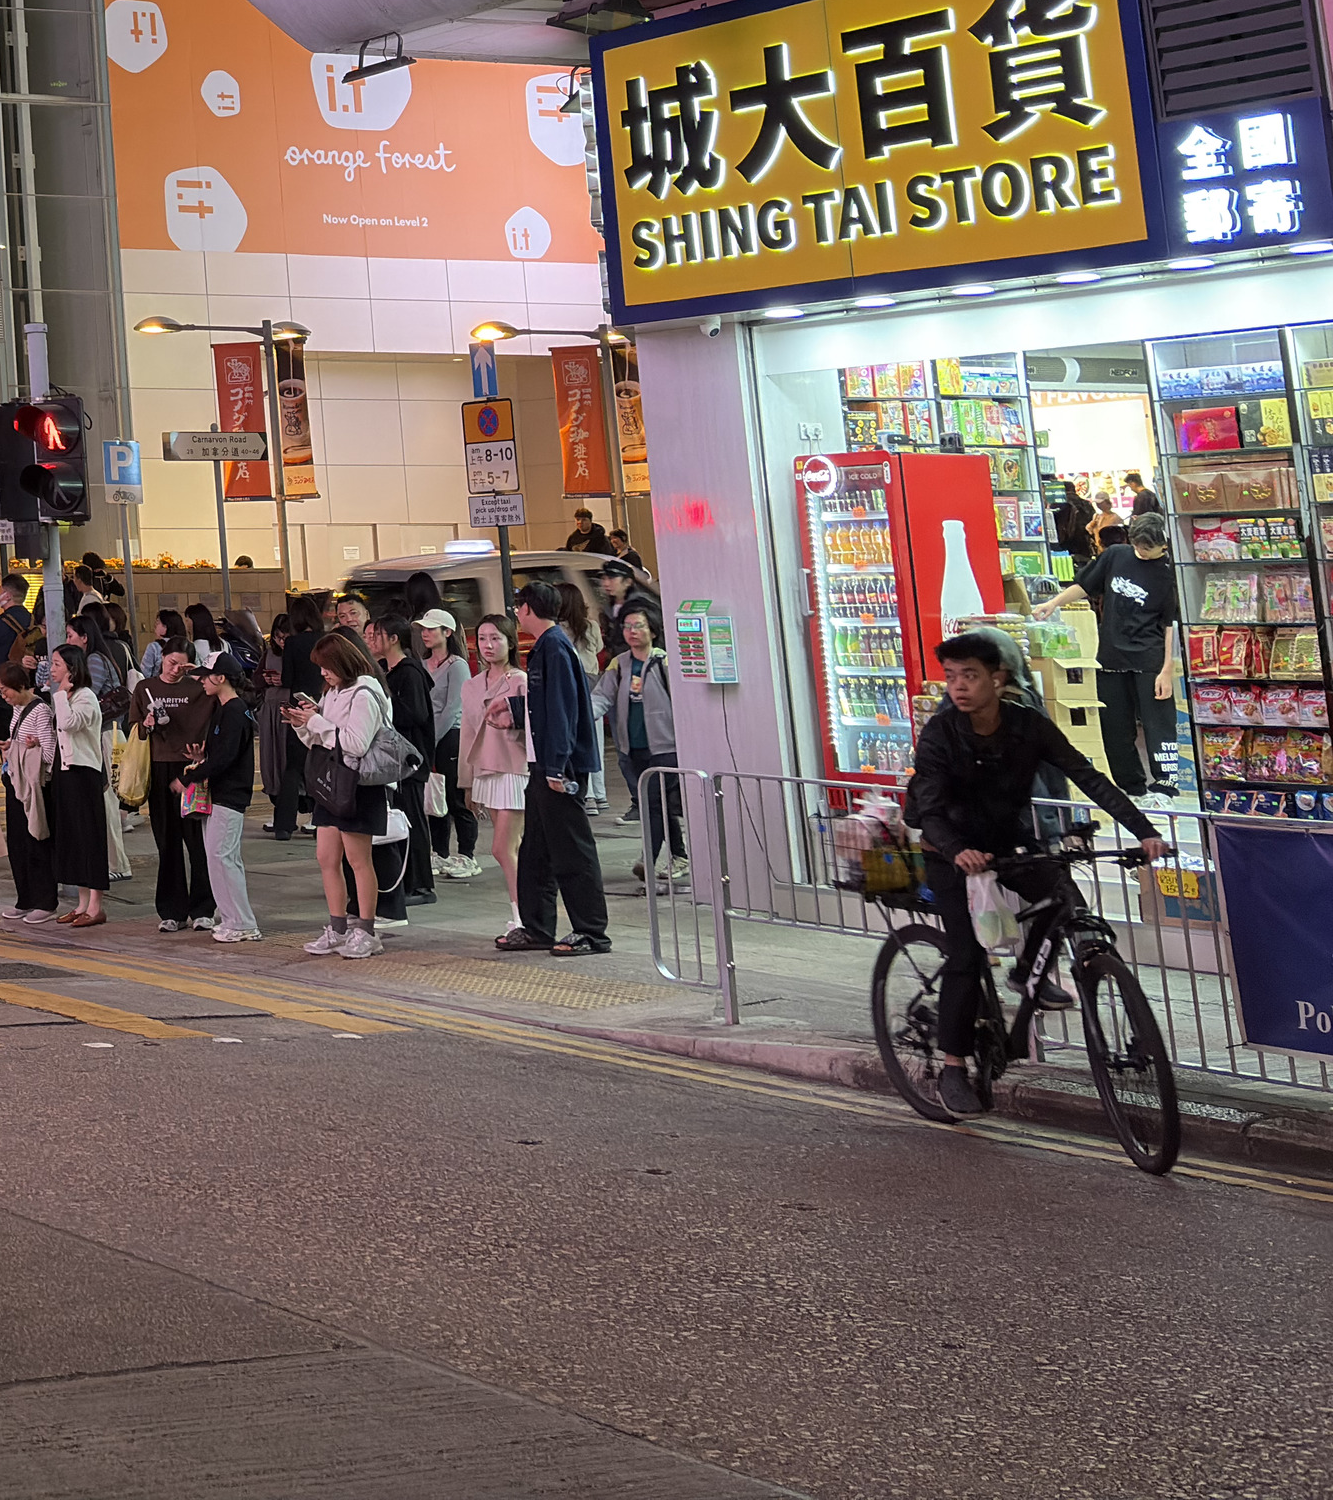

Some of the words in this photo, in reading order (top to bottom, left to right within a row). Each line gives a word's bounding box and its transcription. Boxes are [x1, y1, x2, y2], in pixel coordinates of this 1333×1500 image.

[284, 145, 371, 182] orange
[375, 140, 456, 175] forest
[323, 213, 348, 226] Now
[350, 214, 378, 228] Open
[380, 217, 393, 227] on
[394, 215, 419, 227] Level
[421, 216, 429, 227] 2
[632, 196, 796, 273] SHING
[803, 177, 899, 248] TAI
[907, 144, 1121, 232] STORE
[191, 435, 228, 444] Carnarvon
[229, 435, 247, 444] Road
[229, 387, 250, 481] コメダ店
[110, 446, 134, 482] P
[470, 455, 484, 466] 上午
[485, 446, 513, 463] 8-10
[1295, 1000, 1333, 1034] Po
